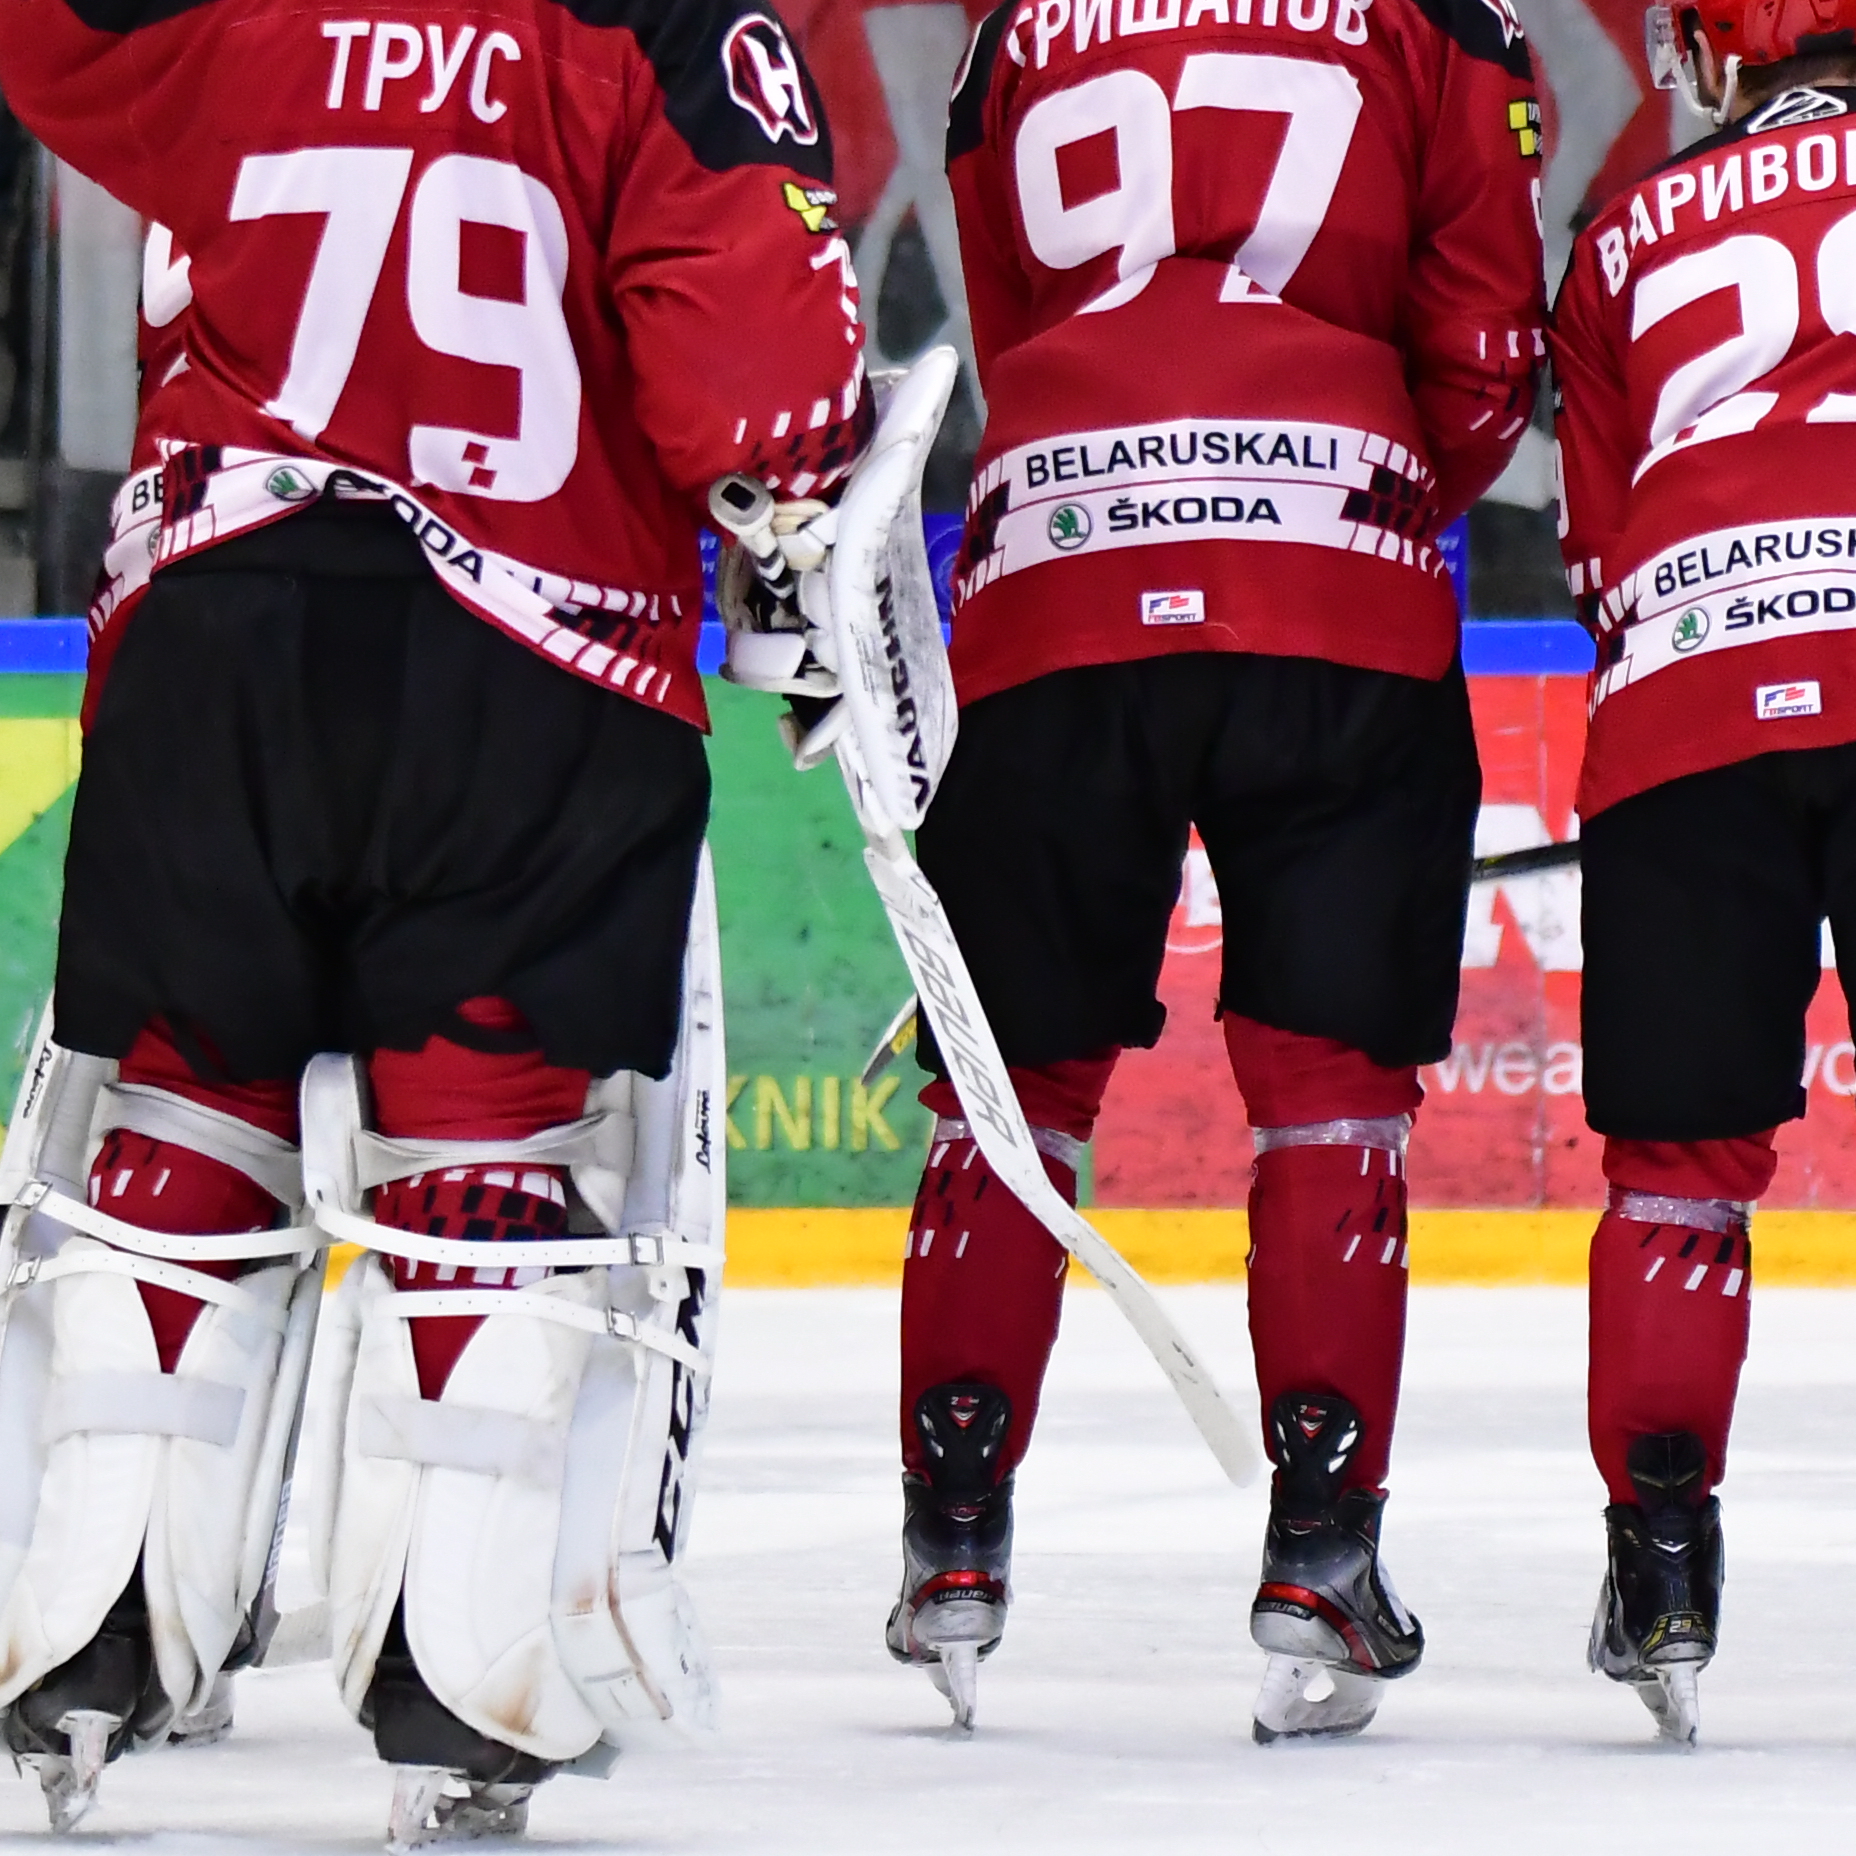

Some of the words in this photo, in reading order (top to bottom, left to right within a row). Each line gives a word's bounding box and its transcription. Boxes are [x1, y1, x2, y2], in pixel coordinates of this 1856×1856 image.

[321, 21, 522, 123] ТРУС
[1014, 52, 1363, 315] 97
[230, 145, 581, 502] 79
[1025, 431, 1339, 489] BELARUSKALI
[1107, 496, 1281, 532] ŠKODA
[876, 574, 930, 813] VAUGHN
